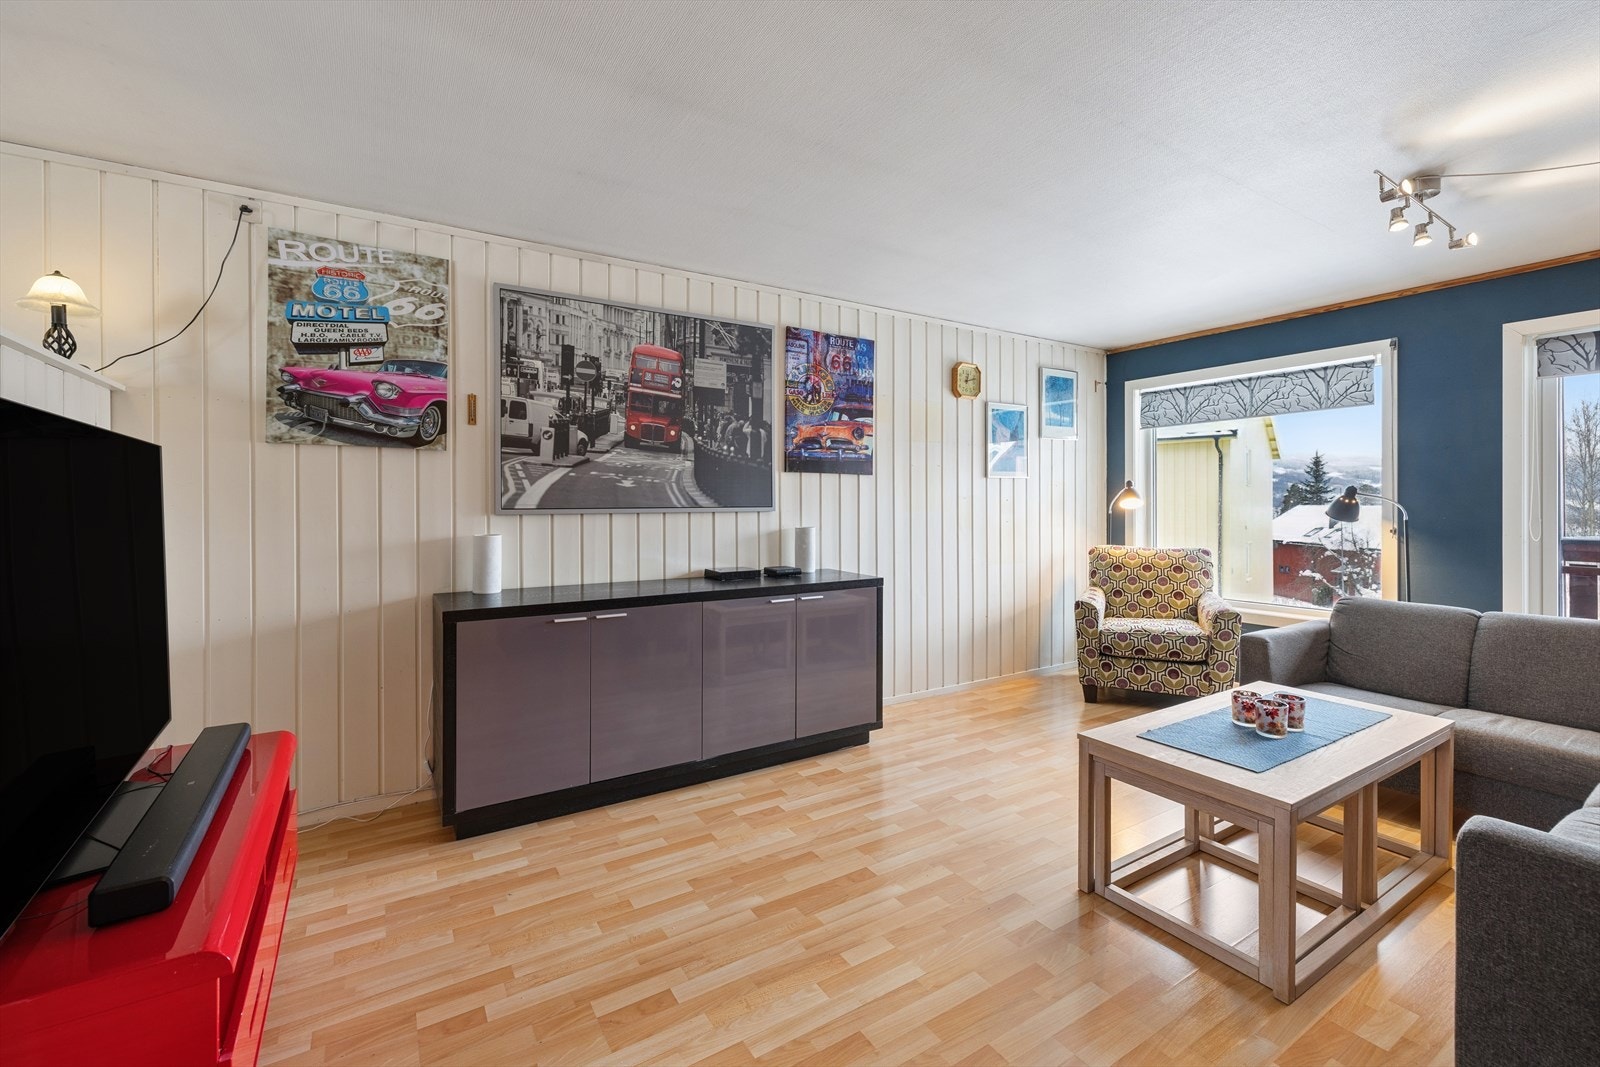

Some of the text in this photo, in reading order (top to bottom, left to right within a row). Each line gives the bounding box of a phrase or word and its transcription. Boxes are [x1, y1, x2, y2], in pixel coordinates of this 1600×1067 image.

[278, 240, 395, 264] ROUTE
[321, 268, 361, 279] HISTORIC
[323, 277, 359, 287] ROUTE
[323, 284, 361, 300] 66
[291, 302, 385, 320] MOTEL
[830, 336, 854, 348] ROUTE
[831, 353, 852, 371] 66
